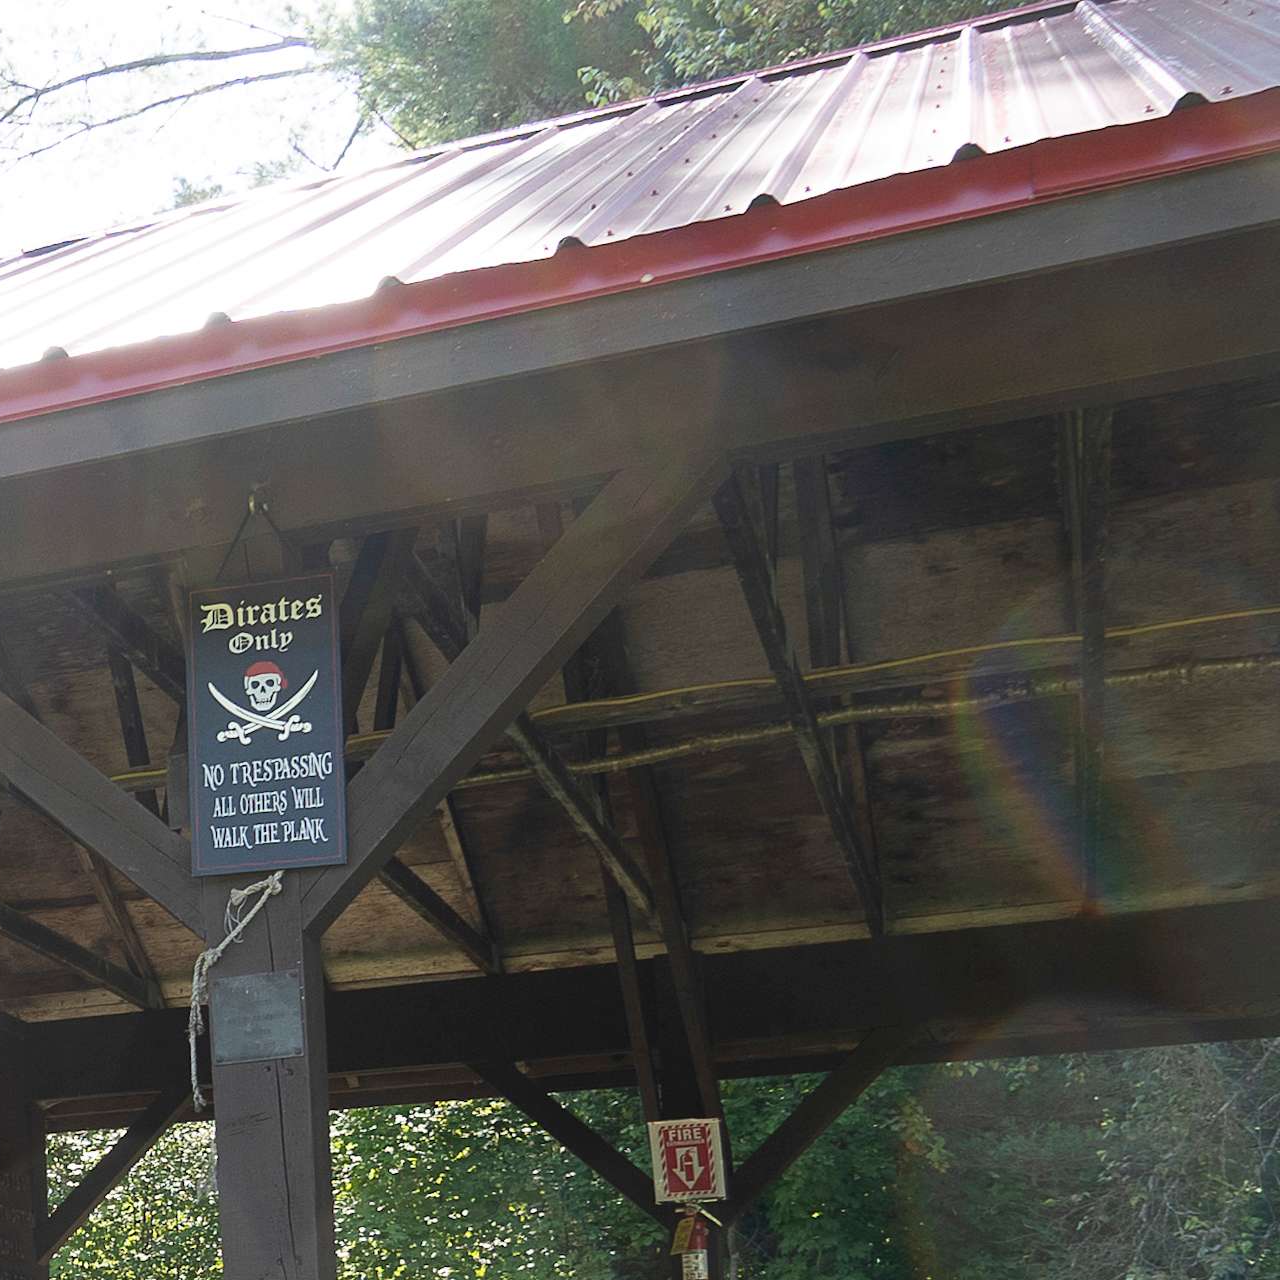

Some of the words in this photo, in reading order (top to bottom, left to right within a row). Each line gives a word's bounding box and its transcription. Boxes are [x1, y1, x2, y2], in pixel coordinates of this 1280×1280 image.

[228, 628, 293, 654] Only
[202, 763, 224, 791] NO
[230, 752, 333, 787] TRESPASSING
[213, 796, 236, 817] ALL
[240, 790, 288, 815] OTHERS
[291, 786, 324, 809] WILL
[210, 825, 253, 849] WALK
[253, 822, 280, 844] THE
[281, 817, 328, 843] PLANK
[668, 1127, 702, 1140] FIRE
